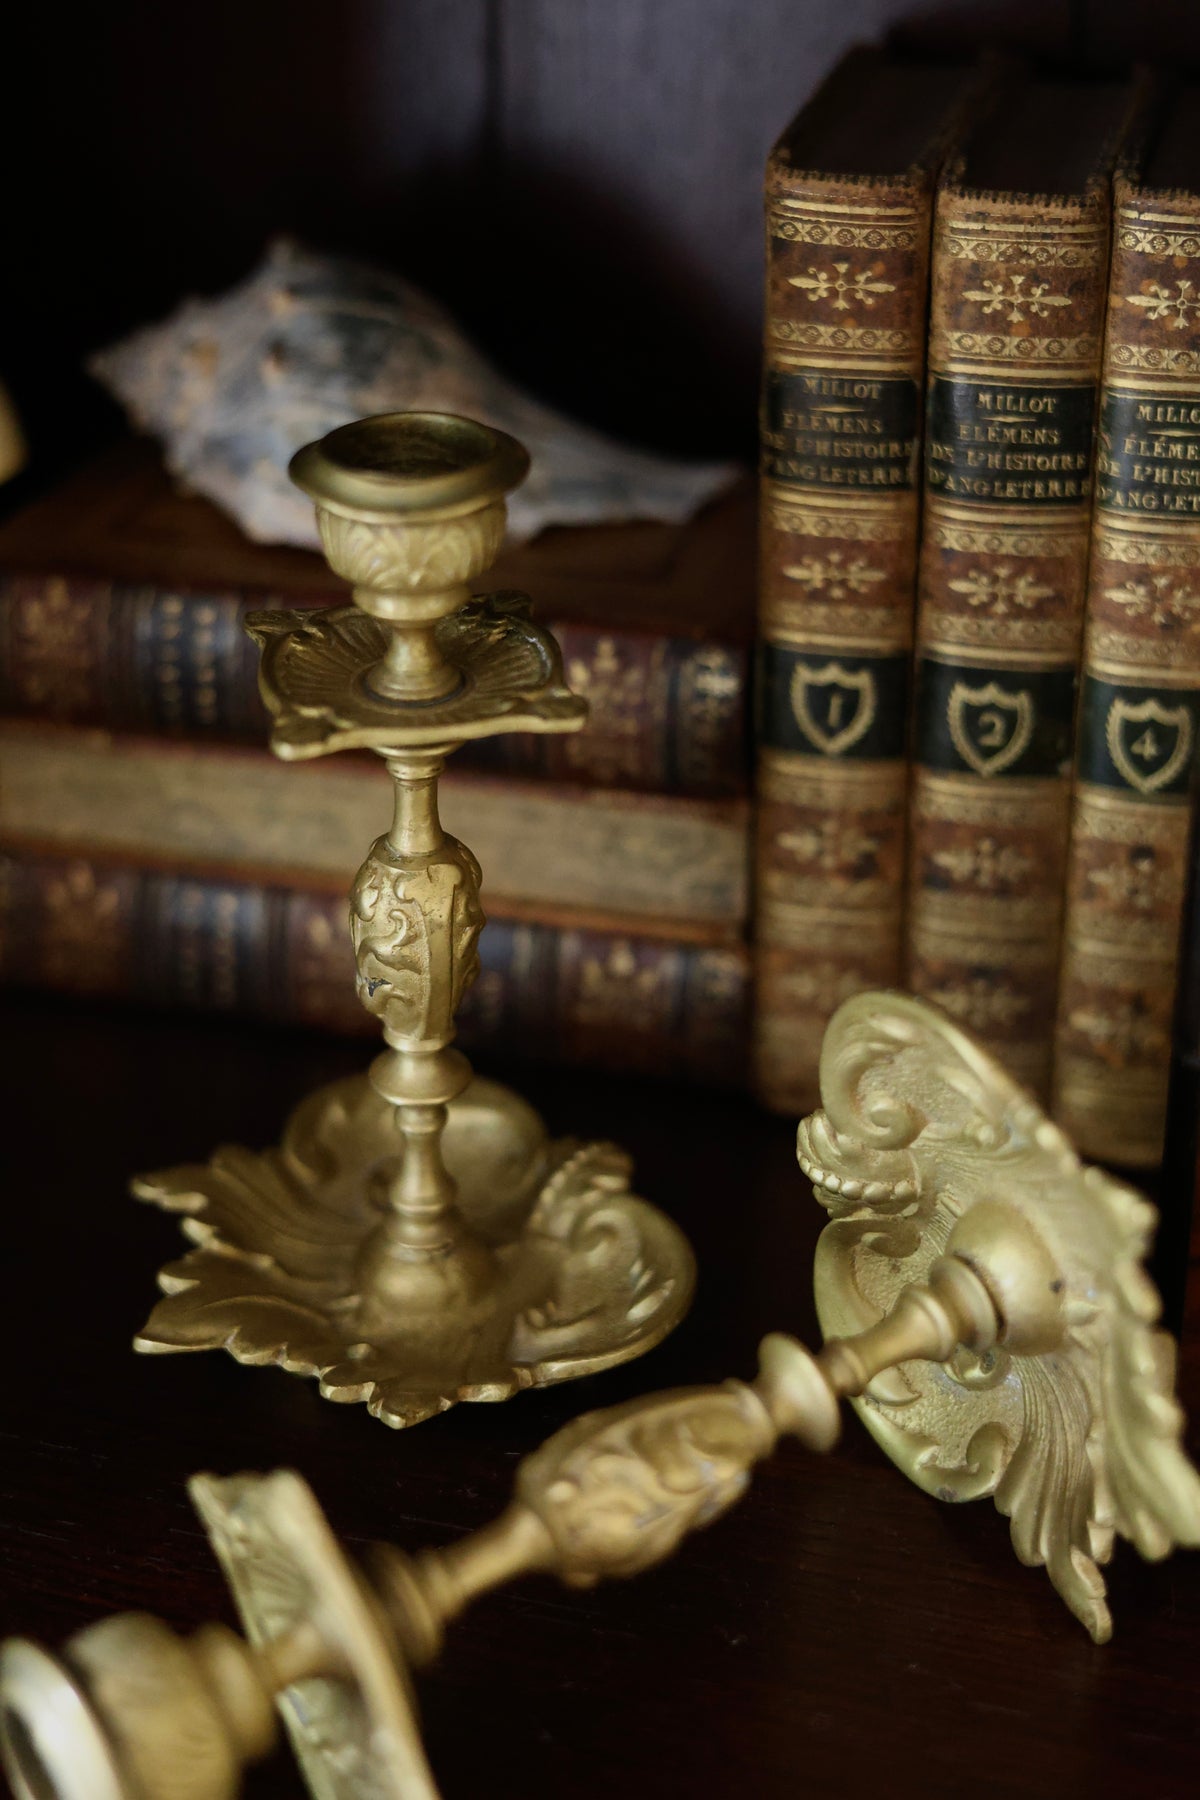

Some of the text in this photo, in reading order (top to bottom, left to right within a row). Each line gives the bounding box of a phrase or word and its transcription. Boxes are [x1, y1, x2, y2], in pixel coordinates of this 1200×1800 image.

[803, 378, 883, 400] MILLOT
[977, 392, 1057, 414] MILLOT
[931, 443, 955, 464] DE
[828, 693, 842, 727] 1
[977, 711, 1005, 746] 2
[1130, 728, 1158, 760] 4
